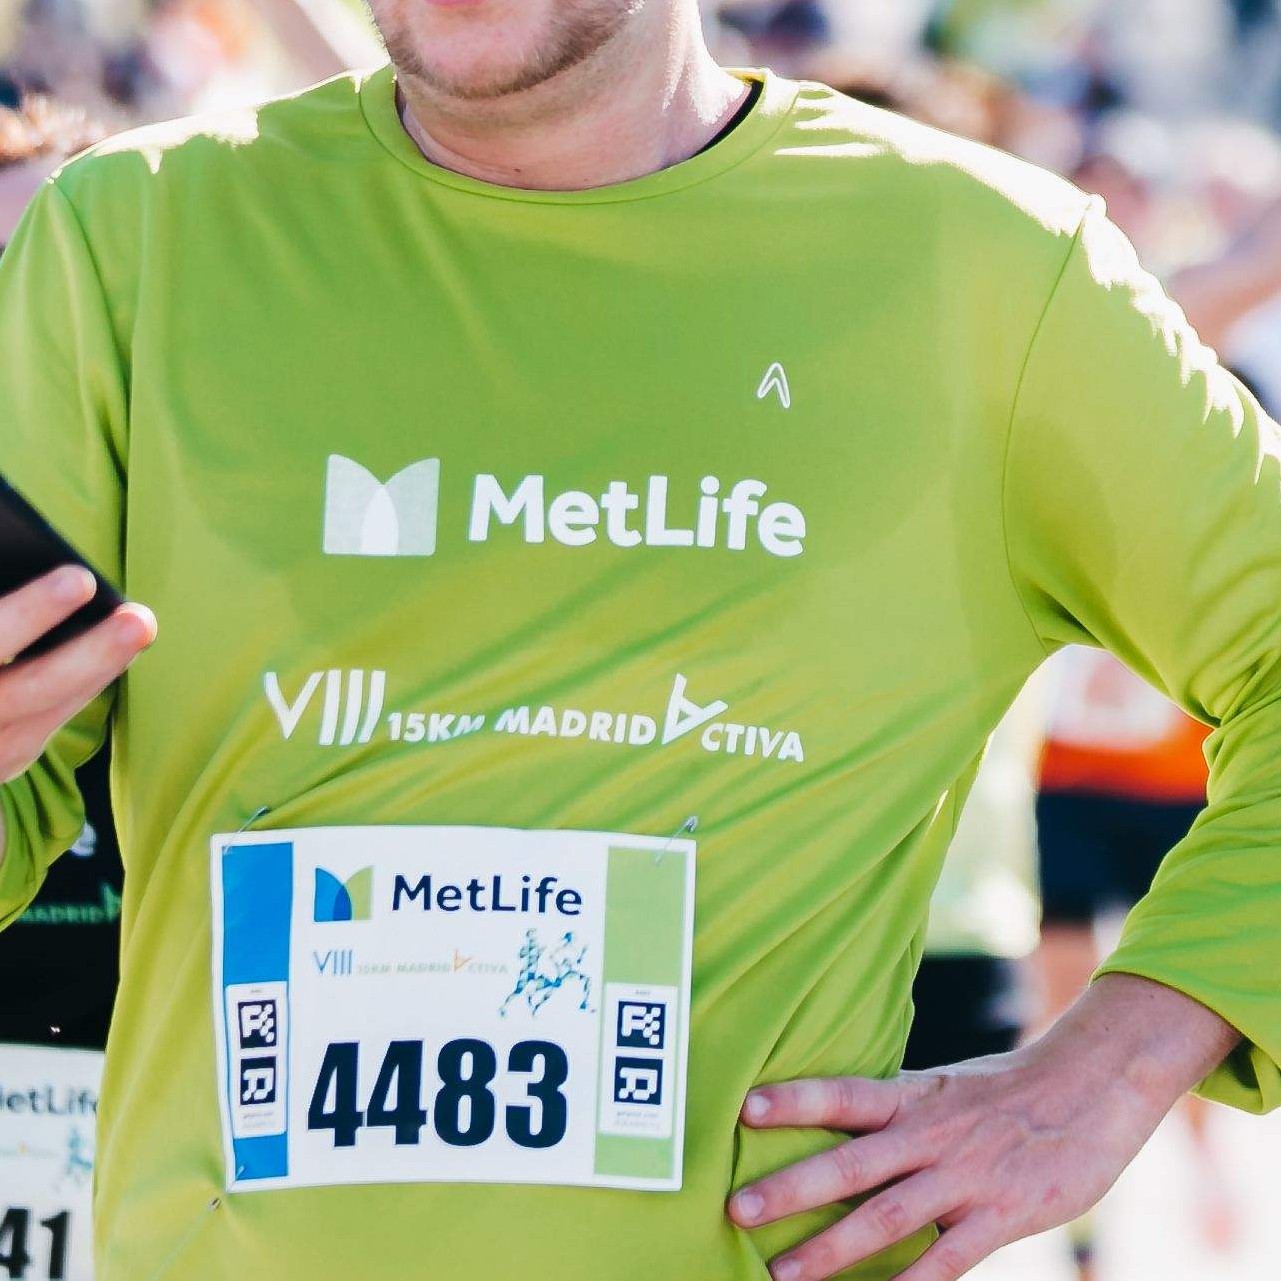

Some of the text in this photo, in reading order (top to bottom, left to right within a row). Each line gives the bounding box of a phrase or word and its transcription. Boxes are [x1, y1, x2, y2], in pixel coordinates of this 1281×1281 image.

[468, 473, 807, 557] MetLife
[264, 668, 386, 746] VIII
[387, 712, 486, 743] 15KM
[493, 705, 657, 746] MADRID
[392, 874, 583, 917] MetLife
[312, 948, 354, 976] VIII
[307, 1038, 569, 1149] 4483
